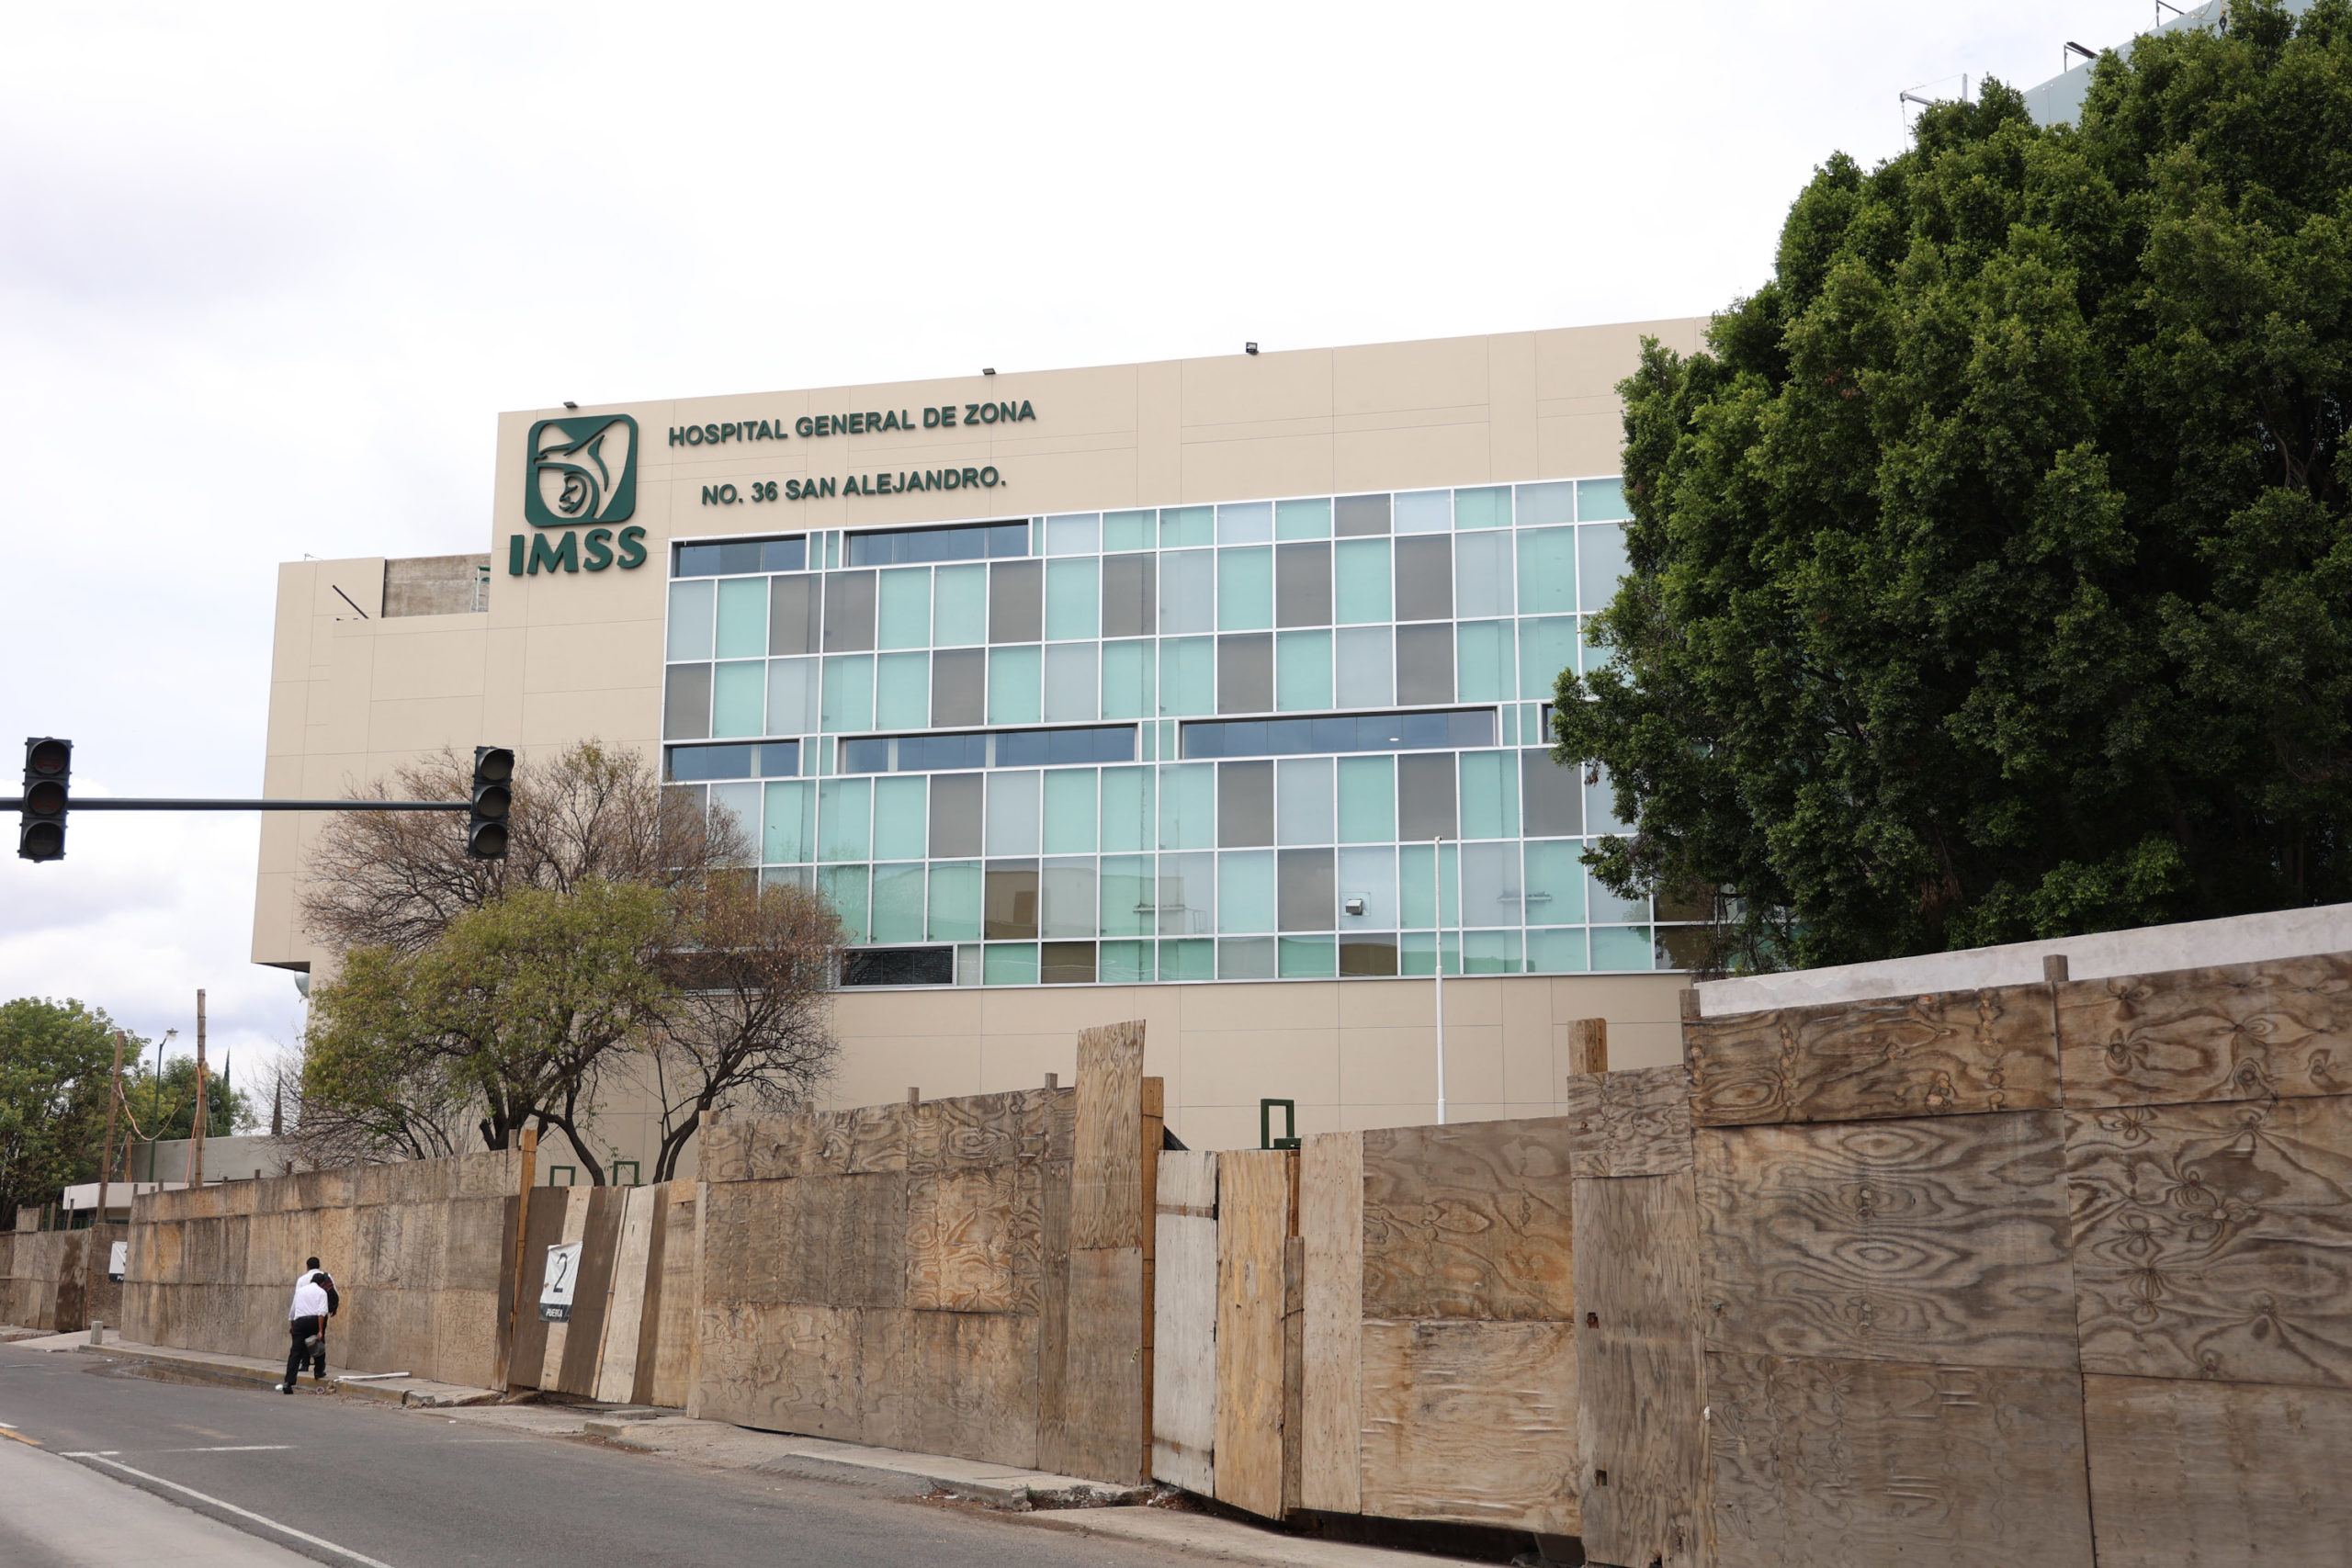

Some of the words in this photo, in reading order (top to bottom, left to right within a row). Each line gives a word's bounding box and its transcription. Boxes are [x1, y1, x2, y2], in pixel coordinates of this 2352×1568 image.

[668, 419, 788, 447] HOSPITAL
[795, 410, 916, 439] GENERAL
[923, 405, 956, 429] DE
[964, 400, 1036, 426] ZONA
[701, 482, 743, 507] NO.
[752, 480, 778, 504] 36
[786, 476, 836, 502] SAN
[842, 466, 1007, 497] ALEJANDRO.
[508, 525, 648, 579] IMSS
[553, 1252, 568, 1292] 2
